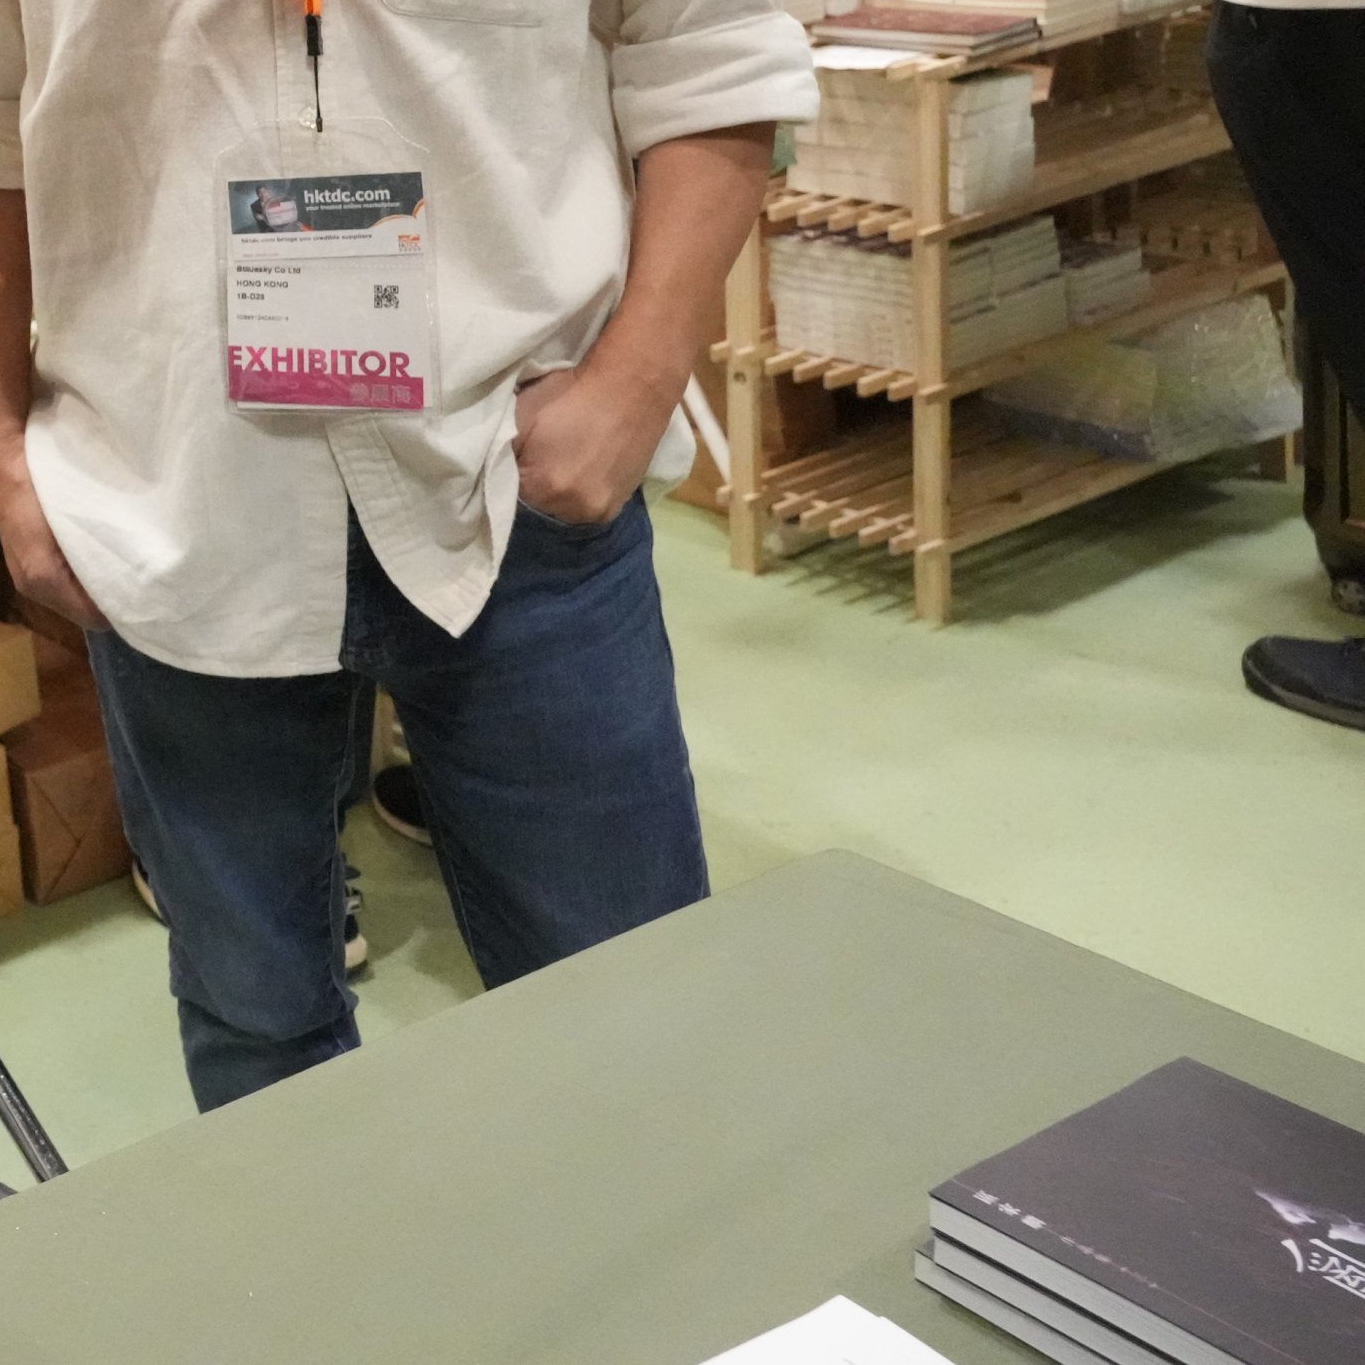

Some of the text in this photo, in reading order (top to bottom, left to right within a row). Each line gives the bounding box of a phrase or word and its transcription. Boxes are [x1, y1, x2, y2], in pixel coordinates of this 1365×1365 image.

[304, 188, 391, 204] hktdc.com
[320, 203, 342, 211] trusted
[343, 202, 362, 210] online
[274, 266, 286, 274] Co
[287, 266, 301, 274] Ltd
[236, 279, 289, 289] HONG KONG
[227, 345, 411, 378] EXHIBITOR
